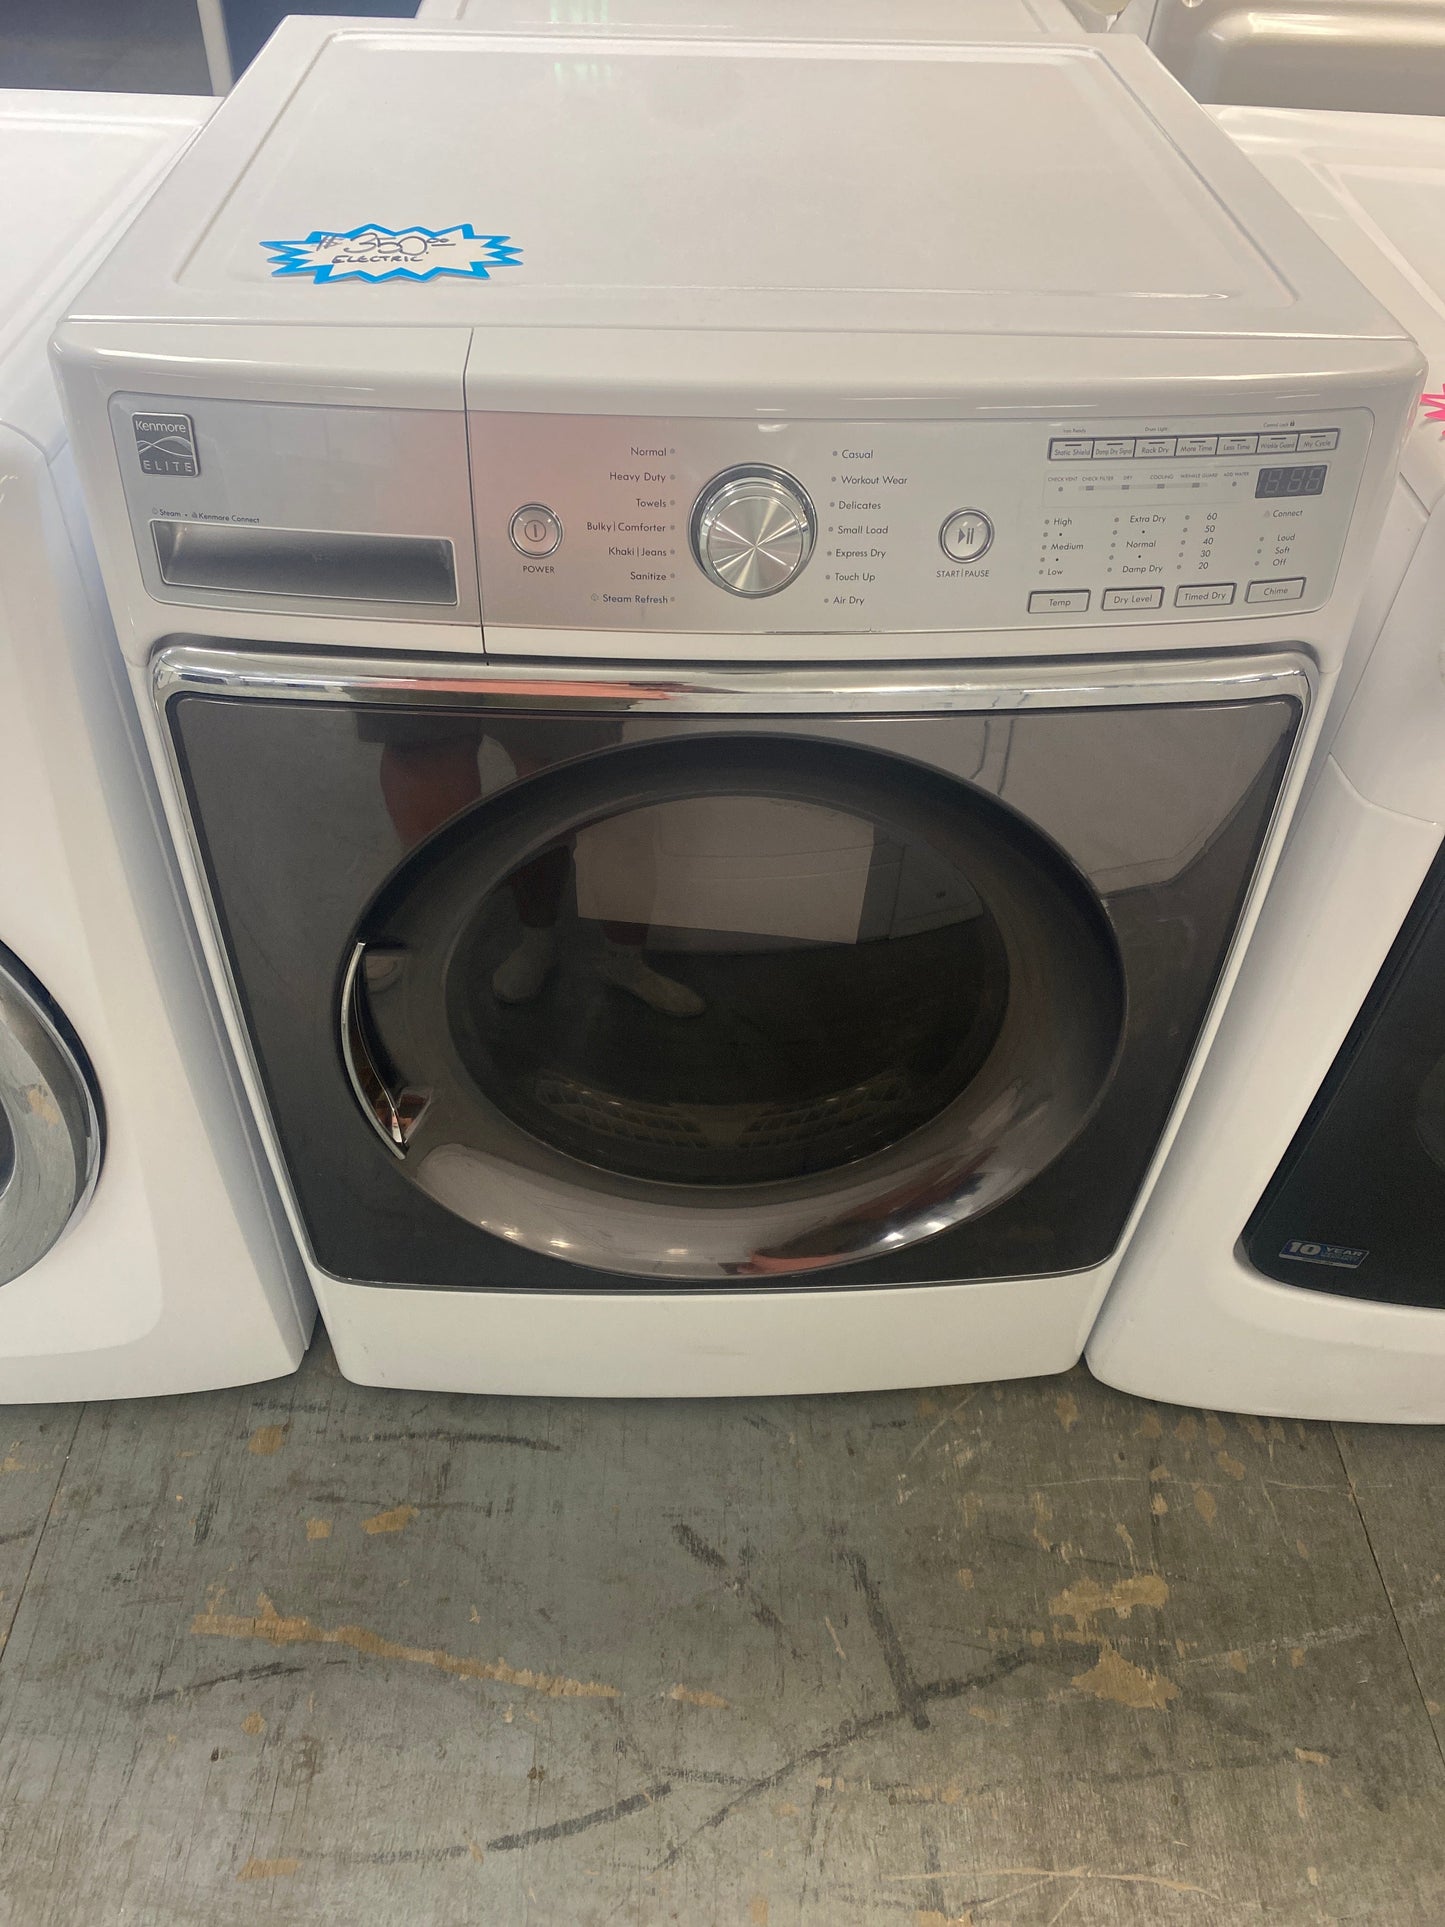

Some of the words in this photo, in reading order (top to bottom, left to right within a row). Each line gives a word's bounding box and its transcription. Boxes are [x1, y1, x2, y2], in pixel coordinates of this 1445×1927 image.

[332, 255, 423, 264] ELECTRIC
[135, 421, 186, 432] Kenmore
[630, 448, 667, 457] Normal
[841, 450, 873, 459] Casual
[143, 460, 193, 472] ELITE
[610, 472, 640, 482] Heavy
[644, 472, 666, 483] Duty
[841, 475, 879, 485] Workout
[882, 475, 908, 485] Wear
[636, 498, 667, 508] Towels
[838, 501, 881, 510] Delicates
[160, 509, 181, 517] Steam
[198, 512, 229, 521] Kenmore
[231, 514, 260, 523] Connect
[1207, 512, 1217, 520] 60
[1273, 510, 1303, 518] Connect
[1053, 518, 1072, 527] High
[1129, 515, 1150, 523] Extra
[1152, 515, 1166, 523] Dry
[838, 526, 863, 535] Small
[866, 526, 888, 534] Load
[1204, 525, 1215, 533] 50
[1126, 540, 1157, 548] Normal
[1203, 537, 1214, 545] 40
[836, 549, 868, 559] Express
[870, 549, 886, 559] Dry
[1200, 550, 1211, 558] 30
[1122, 566, 1146, 574] Damp
[1149, 565, 1163, 573] Dry
[1198, 562, 1208, 570] 20
[630, 572, 667, 581] Sanitize
[1047, 568, 1063, 576] Low
[835, 573, 859, 581] Touch
[862, 573, 875, 582] Up
[602, 594, 632, 603] Steam
[635, 595, 668, 604] Refresh
[833, 596, 846, 604] Air
[849, 596, 865, 606] Dry
[1114, 596, 1128, 605] Dry
[1131, 595, 1153, 603] Level
[1184, 593, 1208, 601] Timed
[1212, 592, 1226, 600] Dry
[1049, 599, 1071, 607] Temp
[1289, 1242, 1320, 1256] 10
